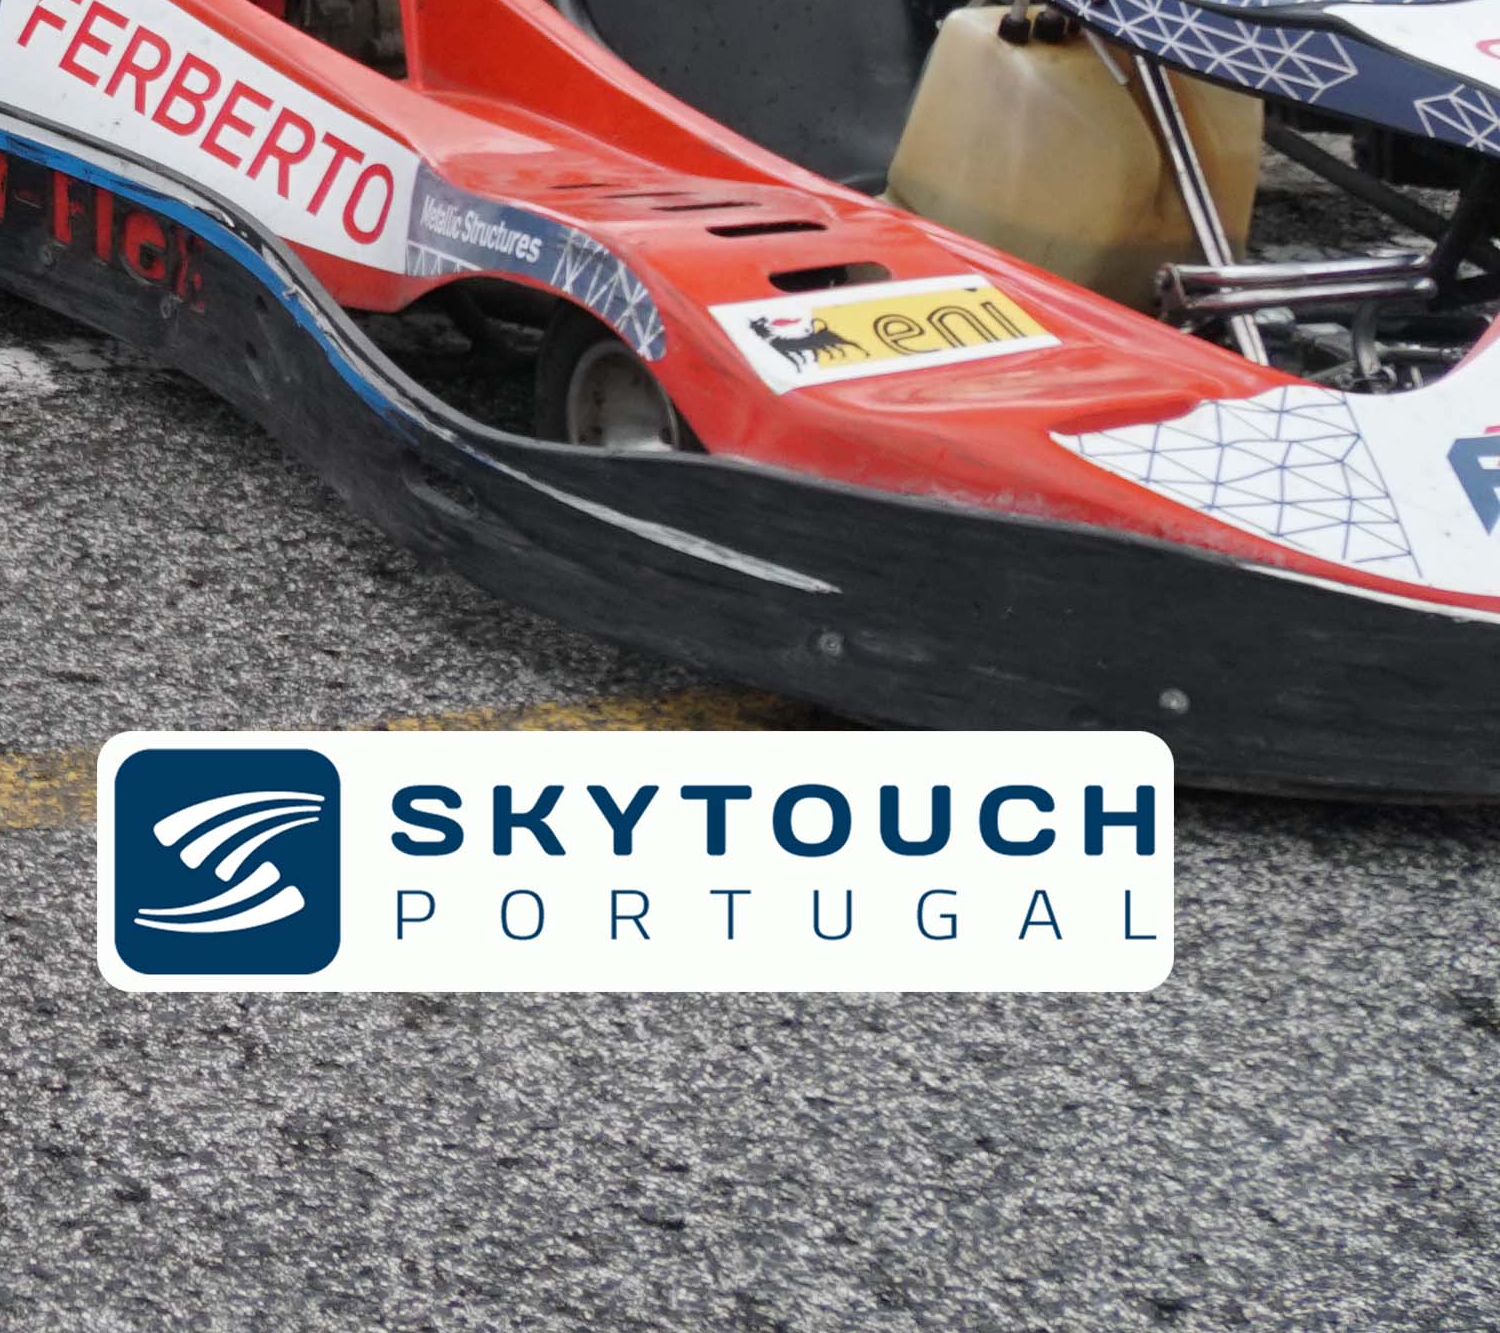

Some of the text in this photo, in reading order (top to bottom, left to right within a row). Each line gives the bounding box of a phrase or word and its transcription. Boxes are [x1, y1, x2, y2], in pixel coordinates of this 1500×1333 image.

[419, 193, 543, 263] Metallic Structures
[871, 283, 1023, 358] eni
